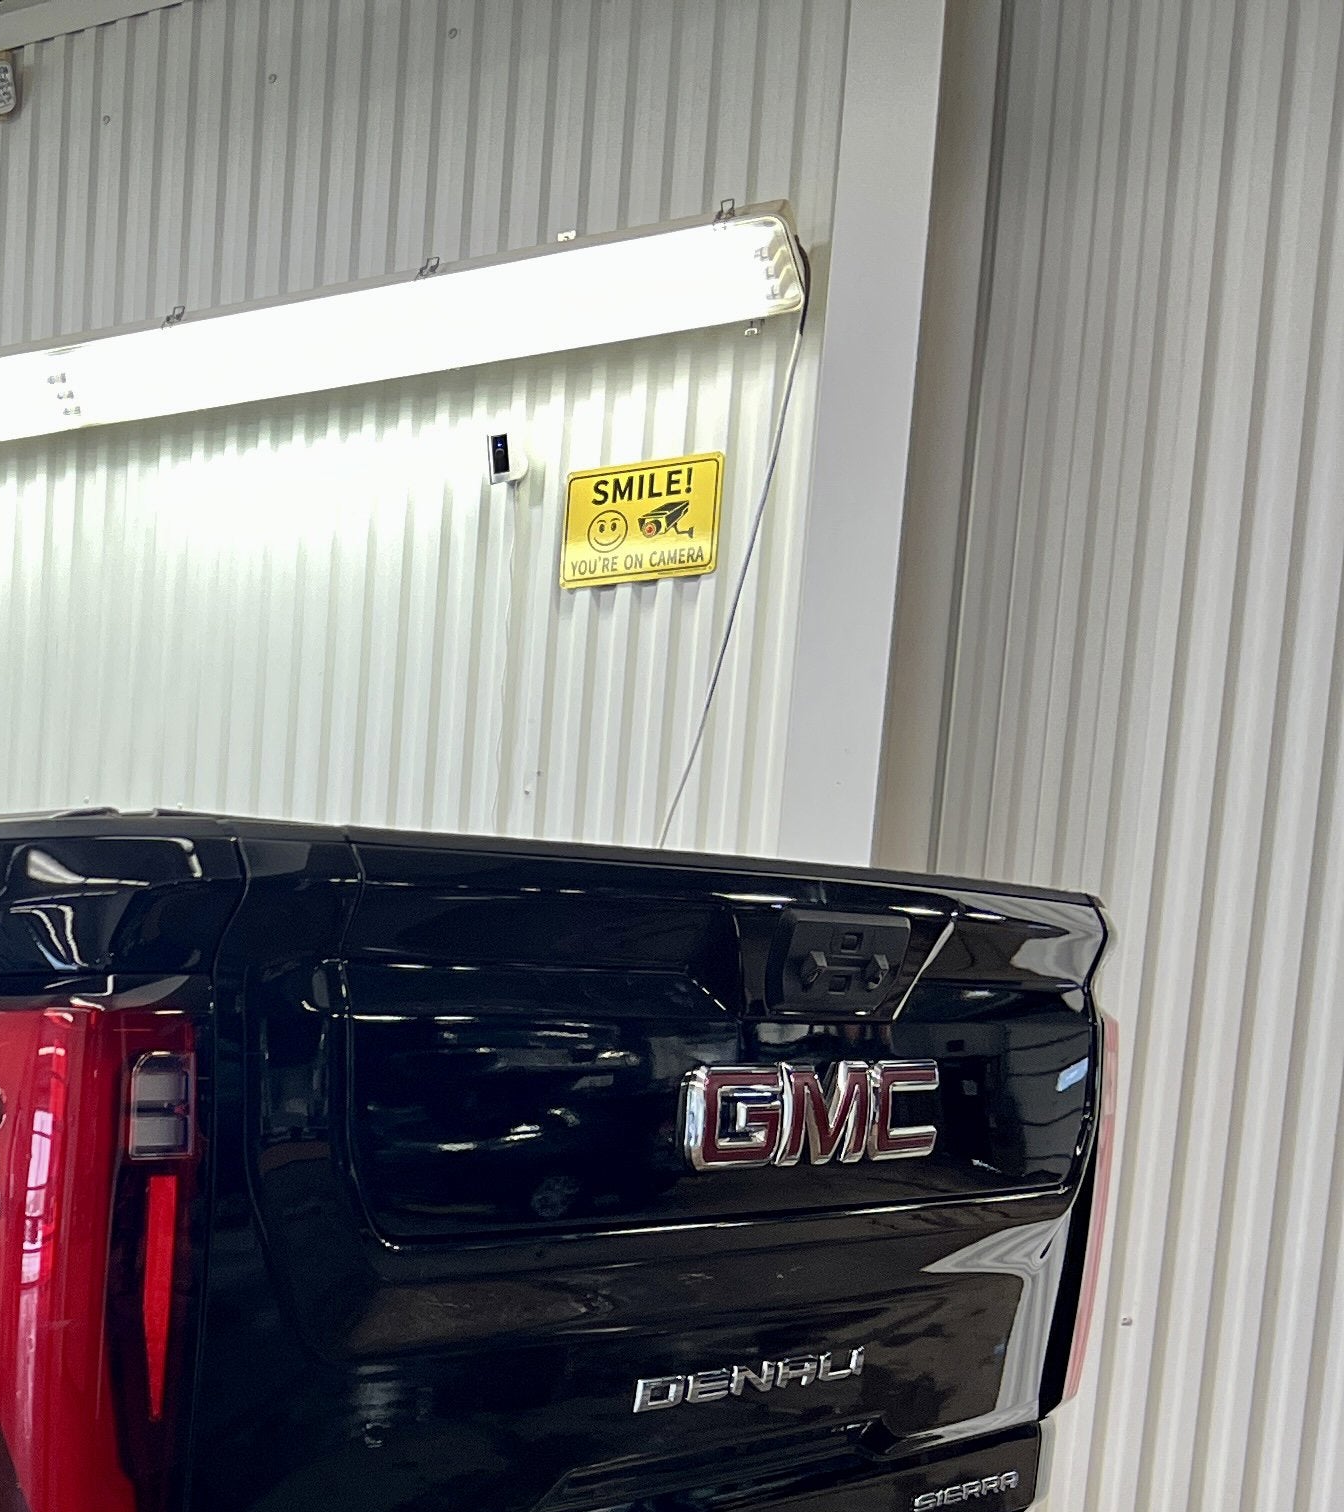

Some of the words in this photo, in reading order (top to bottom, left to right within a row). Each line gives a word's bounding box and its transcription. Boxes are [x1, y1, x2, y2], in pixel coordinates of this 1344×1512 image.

[591, 467, 694, 506] SMILE!
[570, 553, 618, 577] YOU'RE
[624, 552, 644, 571] ON
[648, 546, 705, 568] CAMERA
[680, 1059, 940, 1170] GMC
[633, 1346, 866, 1413] DENALI
[913, 1470, 1019, 1512] SIERRA
